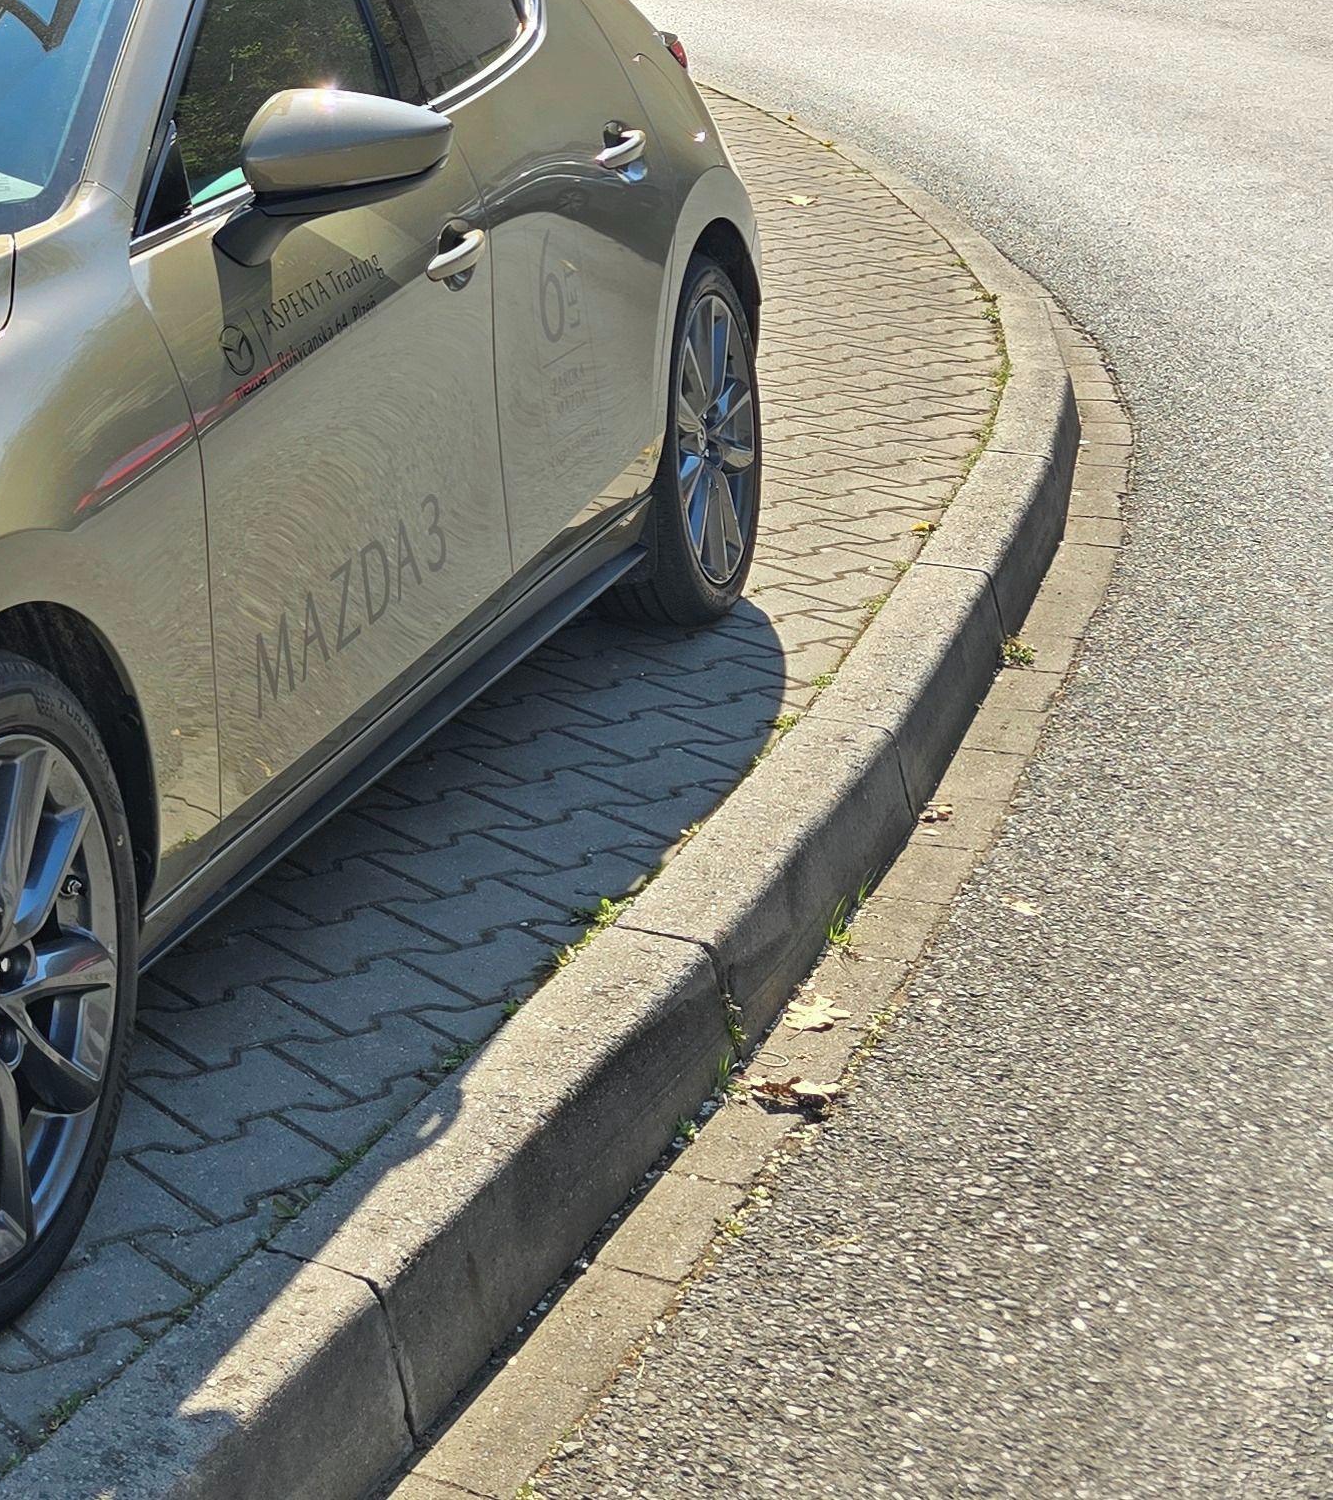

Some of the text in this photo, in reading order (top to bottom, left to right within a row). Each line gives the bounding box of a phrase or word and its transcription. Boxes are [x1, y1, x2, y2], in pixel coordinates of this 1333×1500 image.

[262, 254, 384, 334] ASPEKTA Trading
[539, 228, 565, 344] 6
